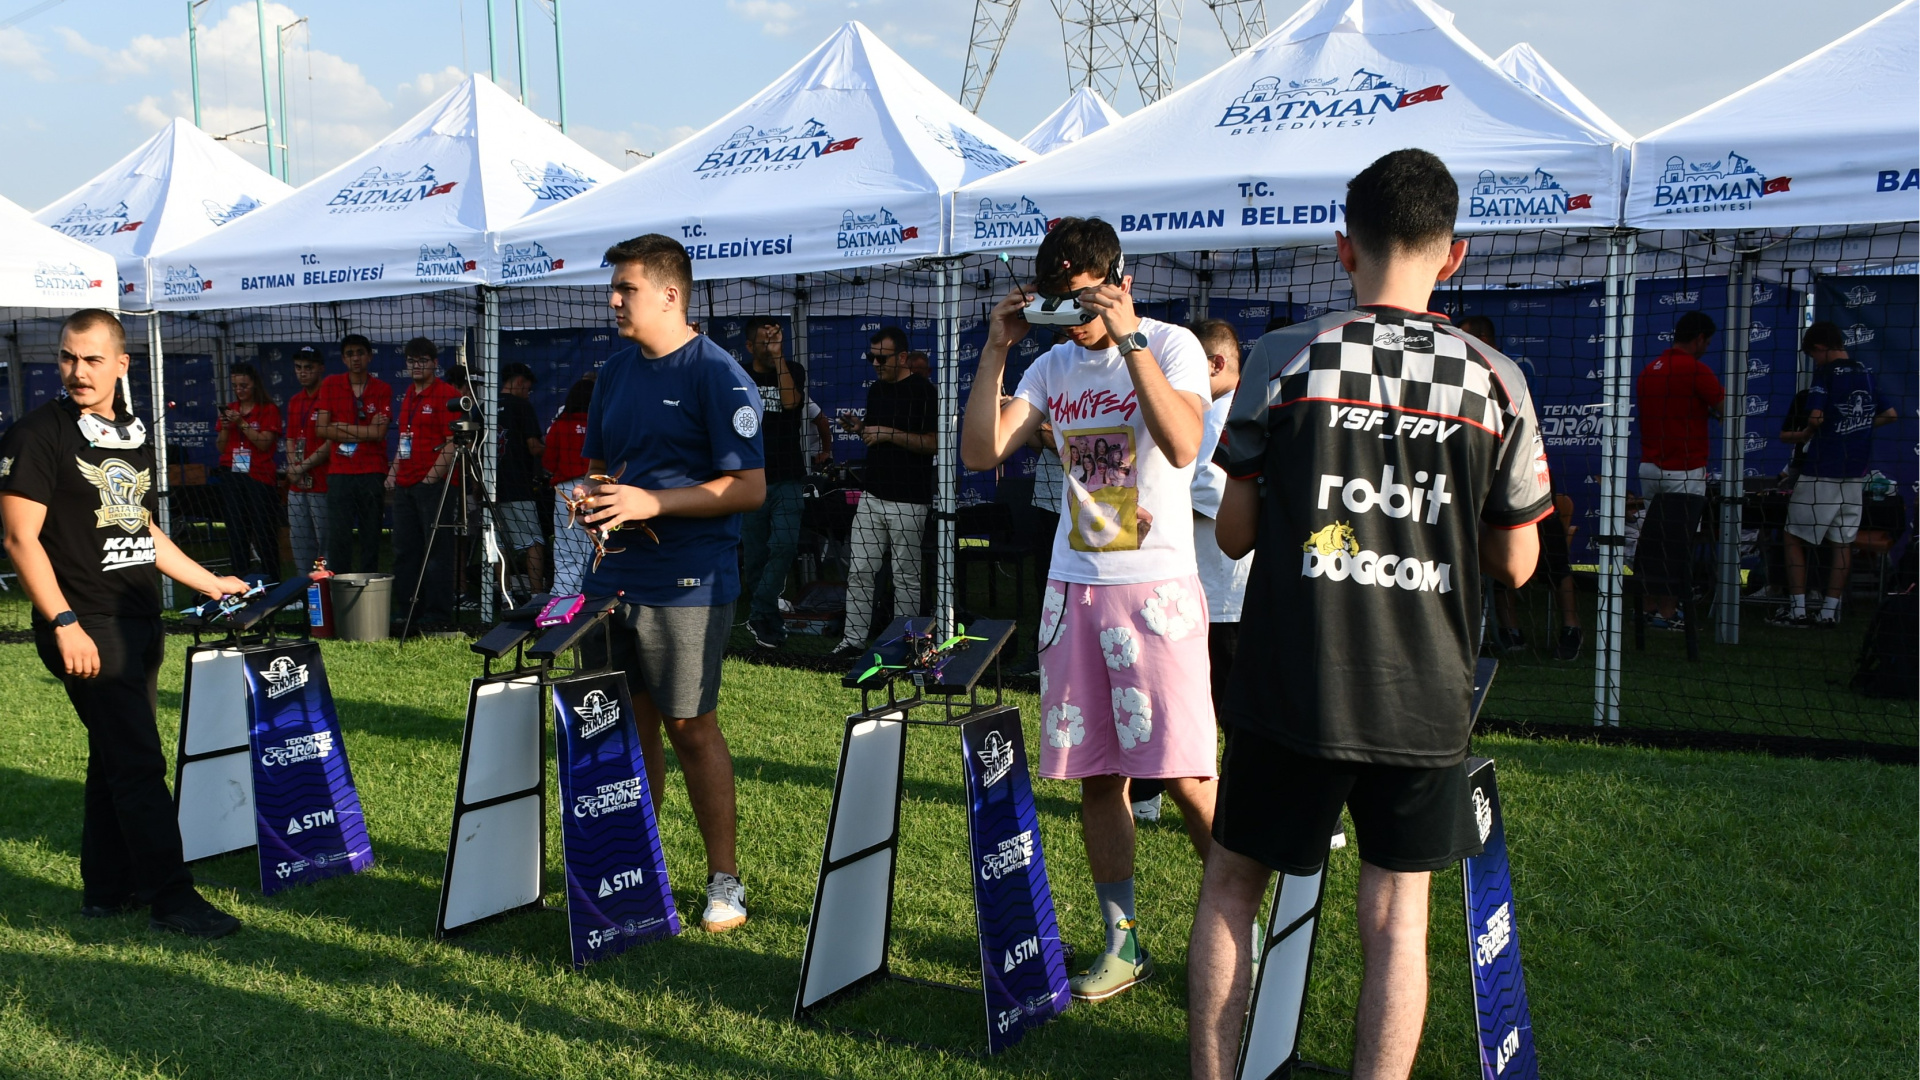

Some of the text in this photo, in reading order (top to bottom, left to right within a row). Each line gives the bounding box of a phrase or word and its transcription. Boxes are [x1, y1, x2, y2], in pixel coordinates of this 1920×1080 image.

[1215, 89, 1408, 128] BATMAN
[1230, 116, 1376, 136] BELEDİYESİ
[693, 140, 833, 173] BATMAN
[700, 161, 802, 180] BELEDİYESİ
[326, 183, 437, 207] BATMAN
[523, 182, 587, 200] BAT
[1238, 182, 1275, 198] T.C.
[1654, 176, 1767, 207] BATMAN
[1120, 199, 1347, 232] BATMAN BELEDİ
[1468, 193, 1571, 218] BATMAN
[682, 224, 707, 238] T.C.
[836, 227, 904, 250] BATMAN
[974, 216, 1049, 240] BATMAN
[301, 253, 321, 265] T.C.
[416, 260, 465, 277] BATMAN
[501, 259, 553, 279] BATMAN
[163, 279, 204, 296] BATMAN
[241, 262, 385, 291] BATMAN BELEDİYESİ
[1328, 404, 1462, 444] YSF_FPV
[1317, 464, 1452, 526] robit
[1301, 547, 1453, 594] DOGCOM
[284, 730, 331, 747] TEKNOFEST
[285, 737, 333, 759] DRONE
[596, 777, 641, 795] TEKNOFEST
[597, 785, 642, 809] DRONE
[303, 809, 335, 832] STM
[997, 830, 1032, 853] TEKNOFEST
[998, 840, 1034, 869] DRONE
[613, 867, 643, 892] STM
[1014, 935, 1039, 965] STM
[1503, 1025, 1520, 1063] STM
